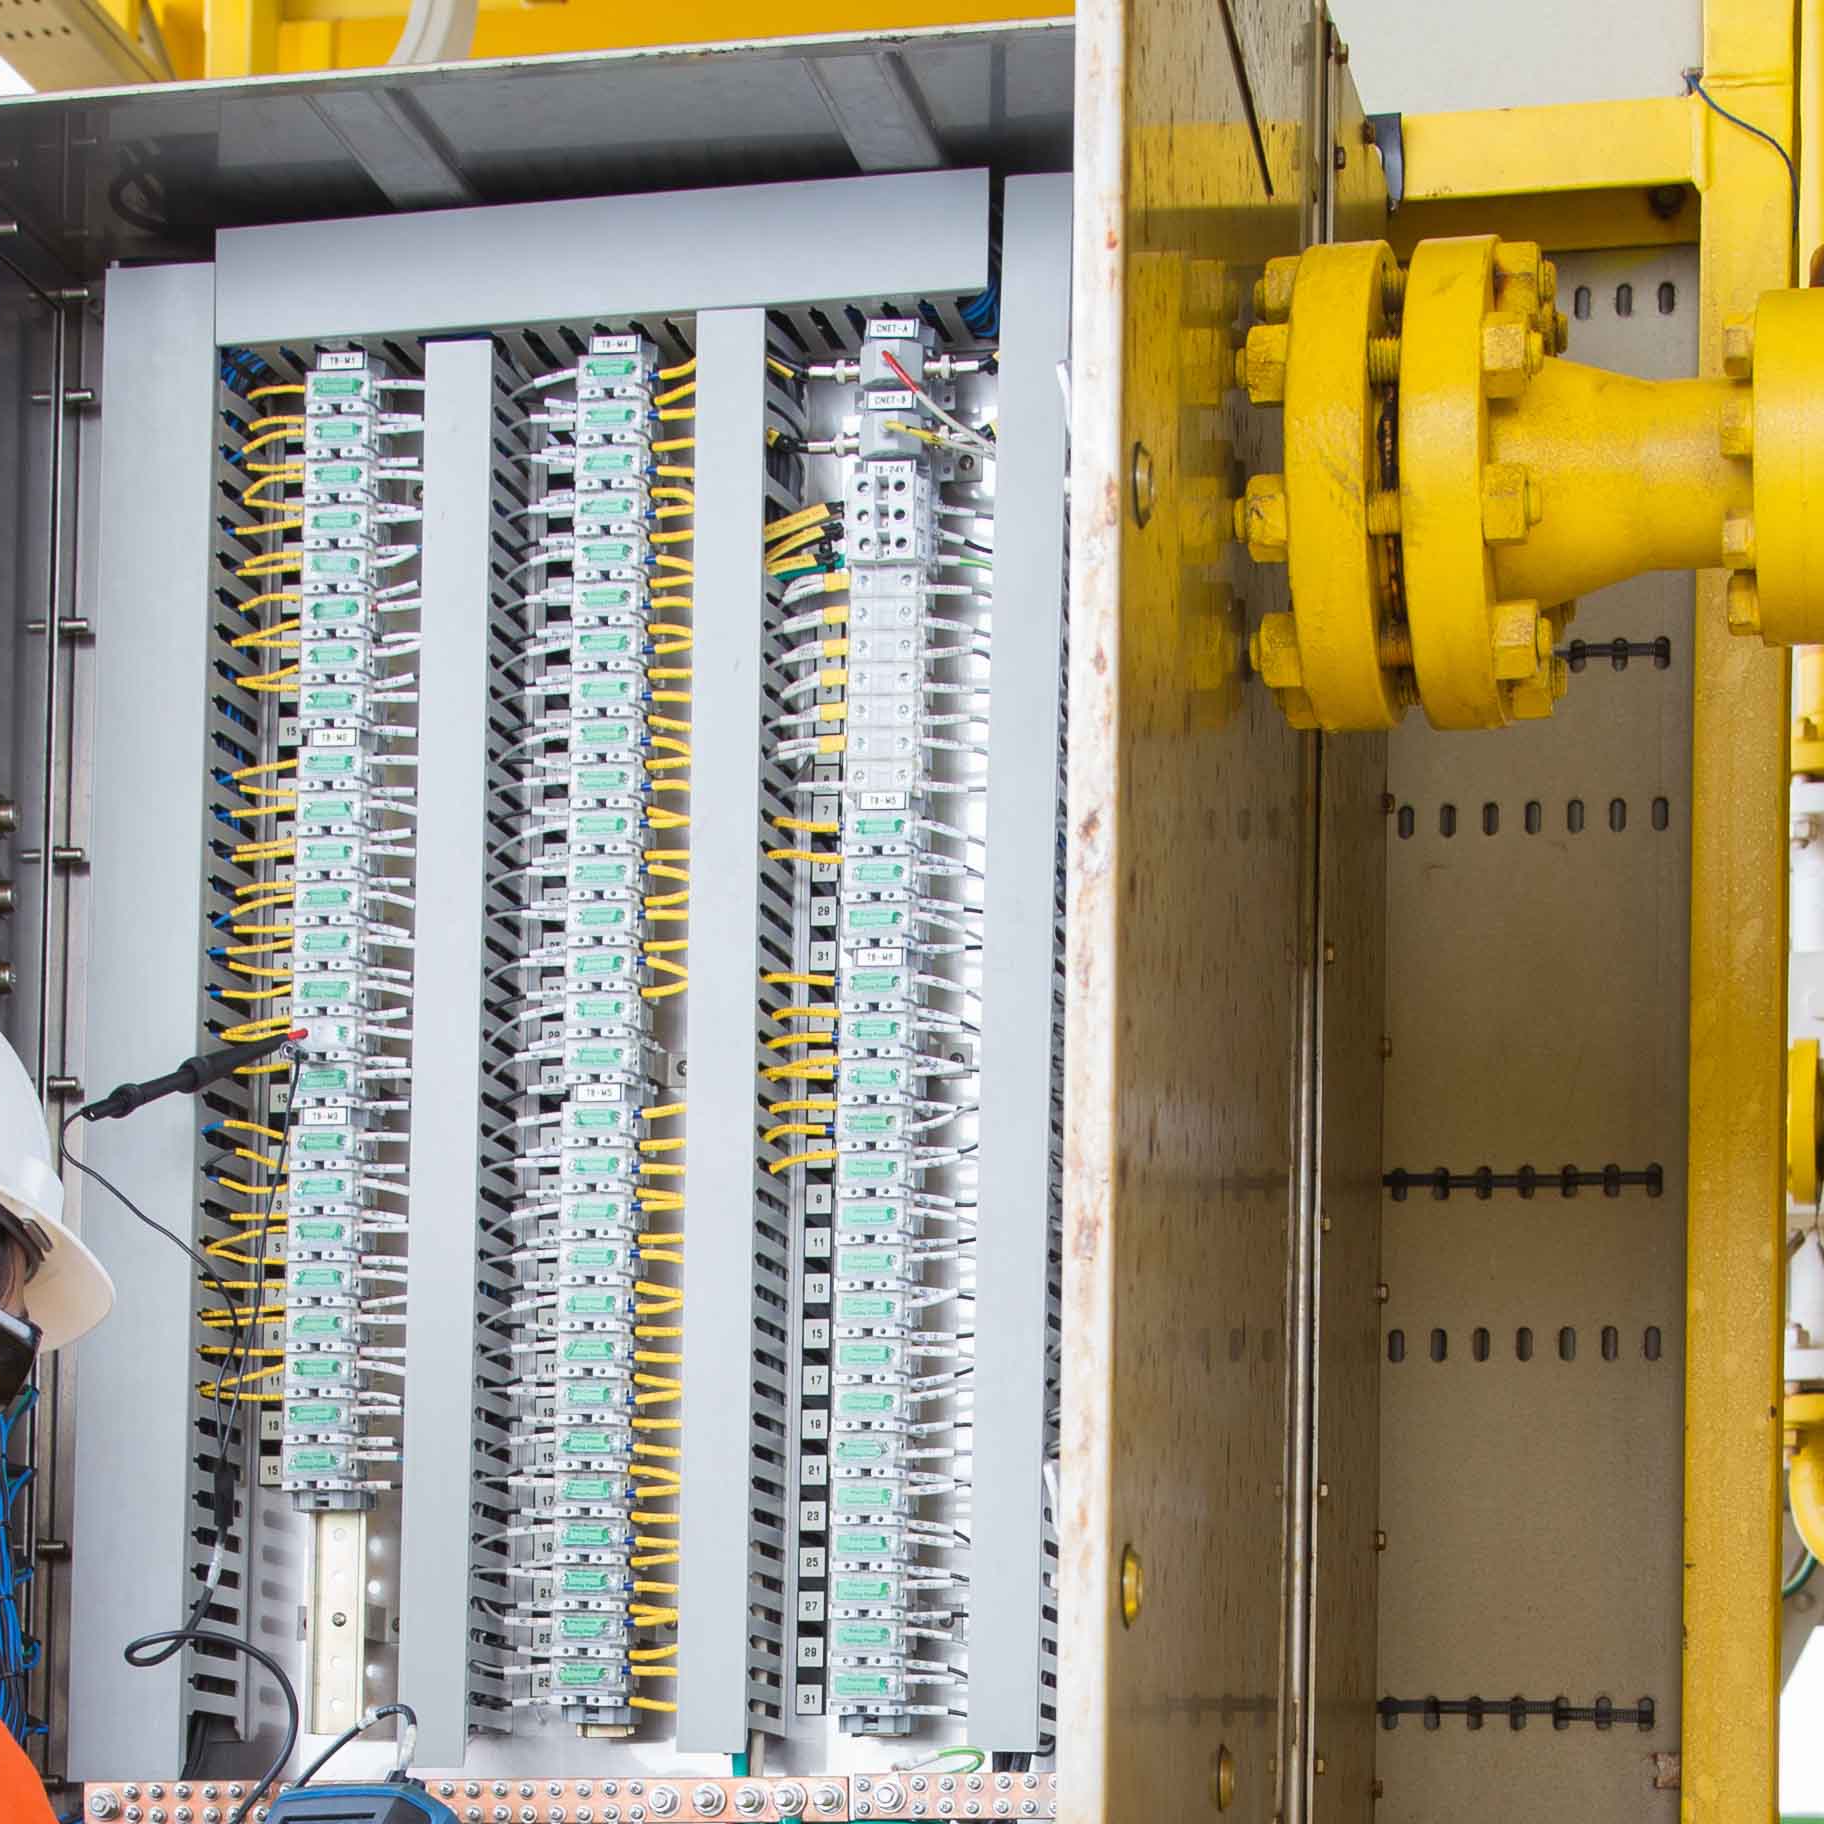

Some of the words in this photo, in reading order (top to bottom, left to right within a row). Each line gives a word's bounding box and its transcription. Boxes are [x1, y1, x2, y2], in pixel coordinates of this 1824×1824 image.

[876, 323, 908, 333] CNET-A
[286, 725, 297, 737] 15
[817, 905, 830, 917] 29
[817, 951, 829, 962] 31
[280, 1005, 290, 1016] 11
[277, 1092, 290, 1106] 15
[813, 1237, 824, 1247] 11
[812, 1283, 824, 1294] 13
[812, 1328, 823, 1339] 15
[544, 1363, 555, 1373] 11
[270, 1375, 280, 1387] 11
[811, 1375, 822, 1385] 17
[543, 1407, 555, 1418] 13
[268, 1420, 280, 1431] 13
[543, 1452, 555, 1463] 15
[267, 1464, 279, 1476] 15
[808, 1464, 820, 1476] 21
[543, 1495, 555, 1507] 17
[807, 1510, 820, 1521] 23
[805, 1556, 819, 1568] 25
[805, 1600, 818, 1612] 27
[803, 1693, 816, 1705] 31
